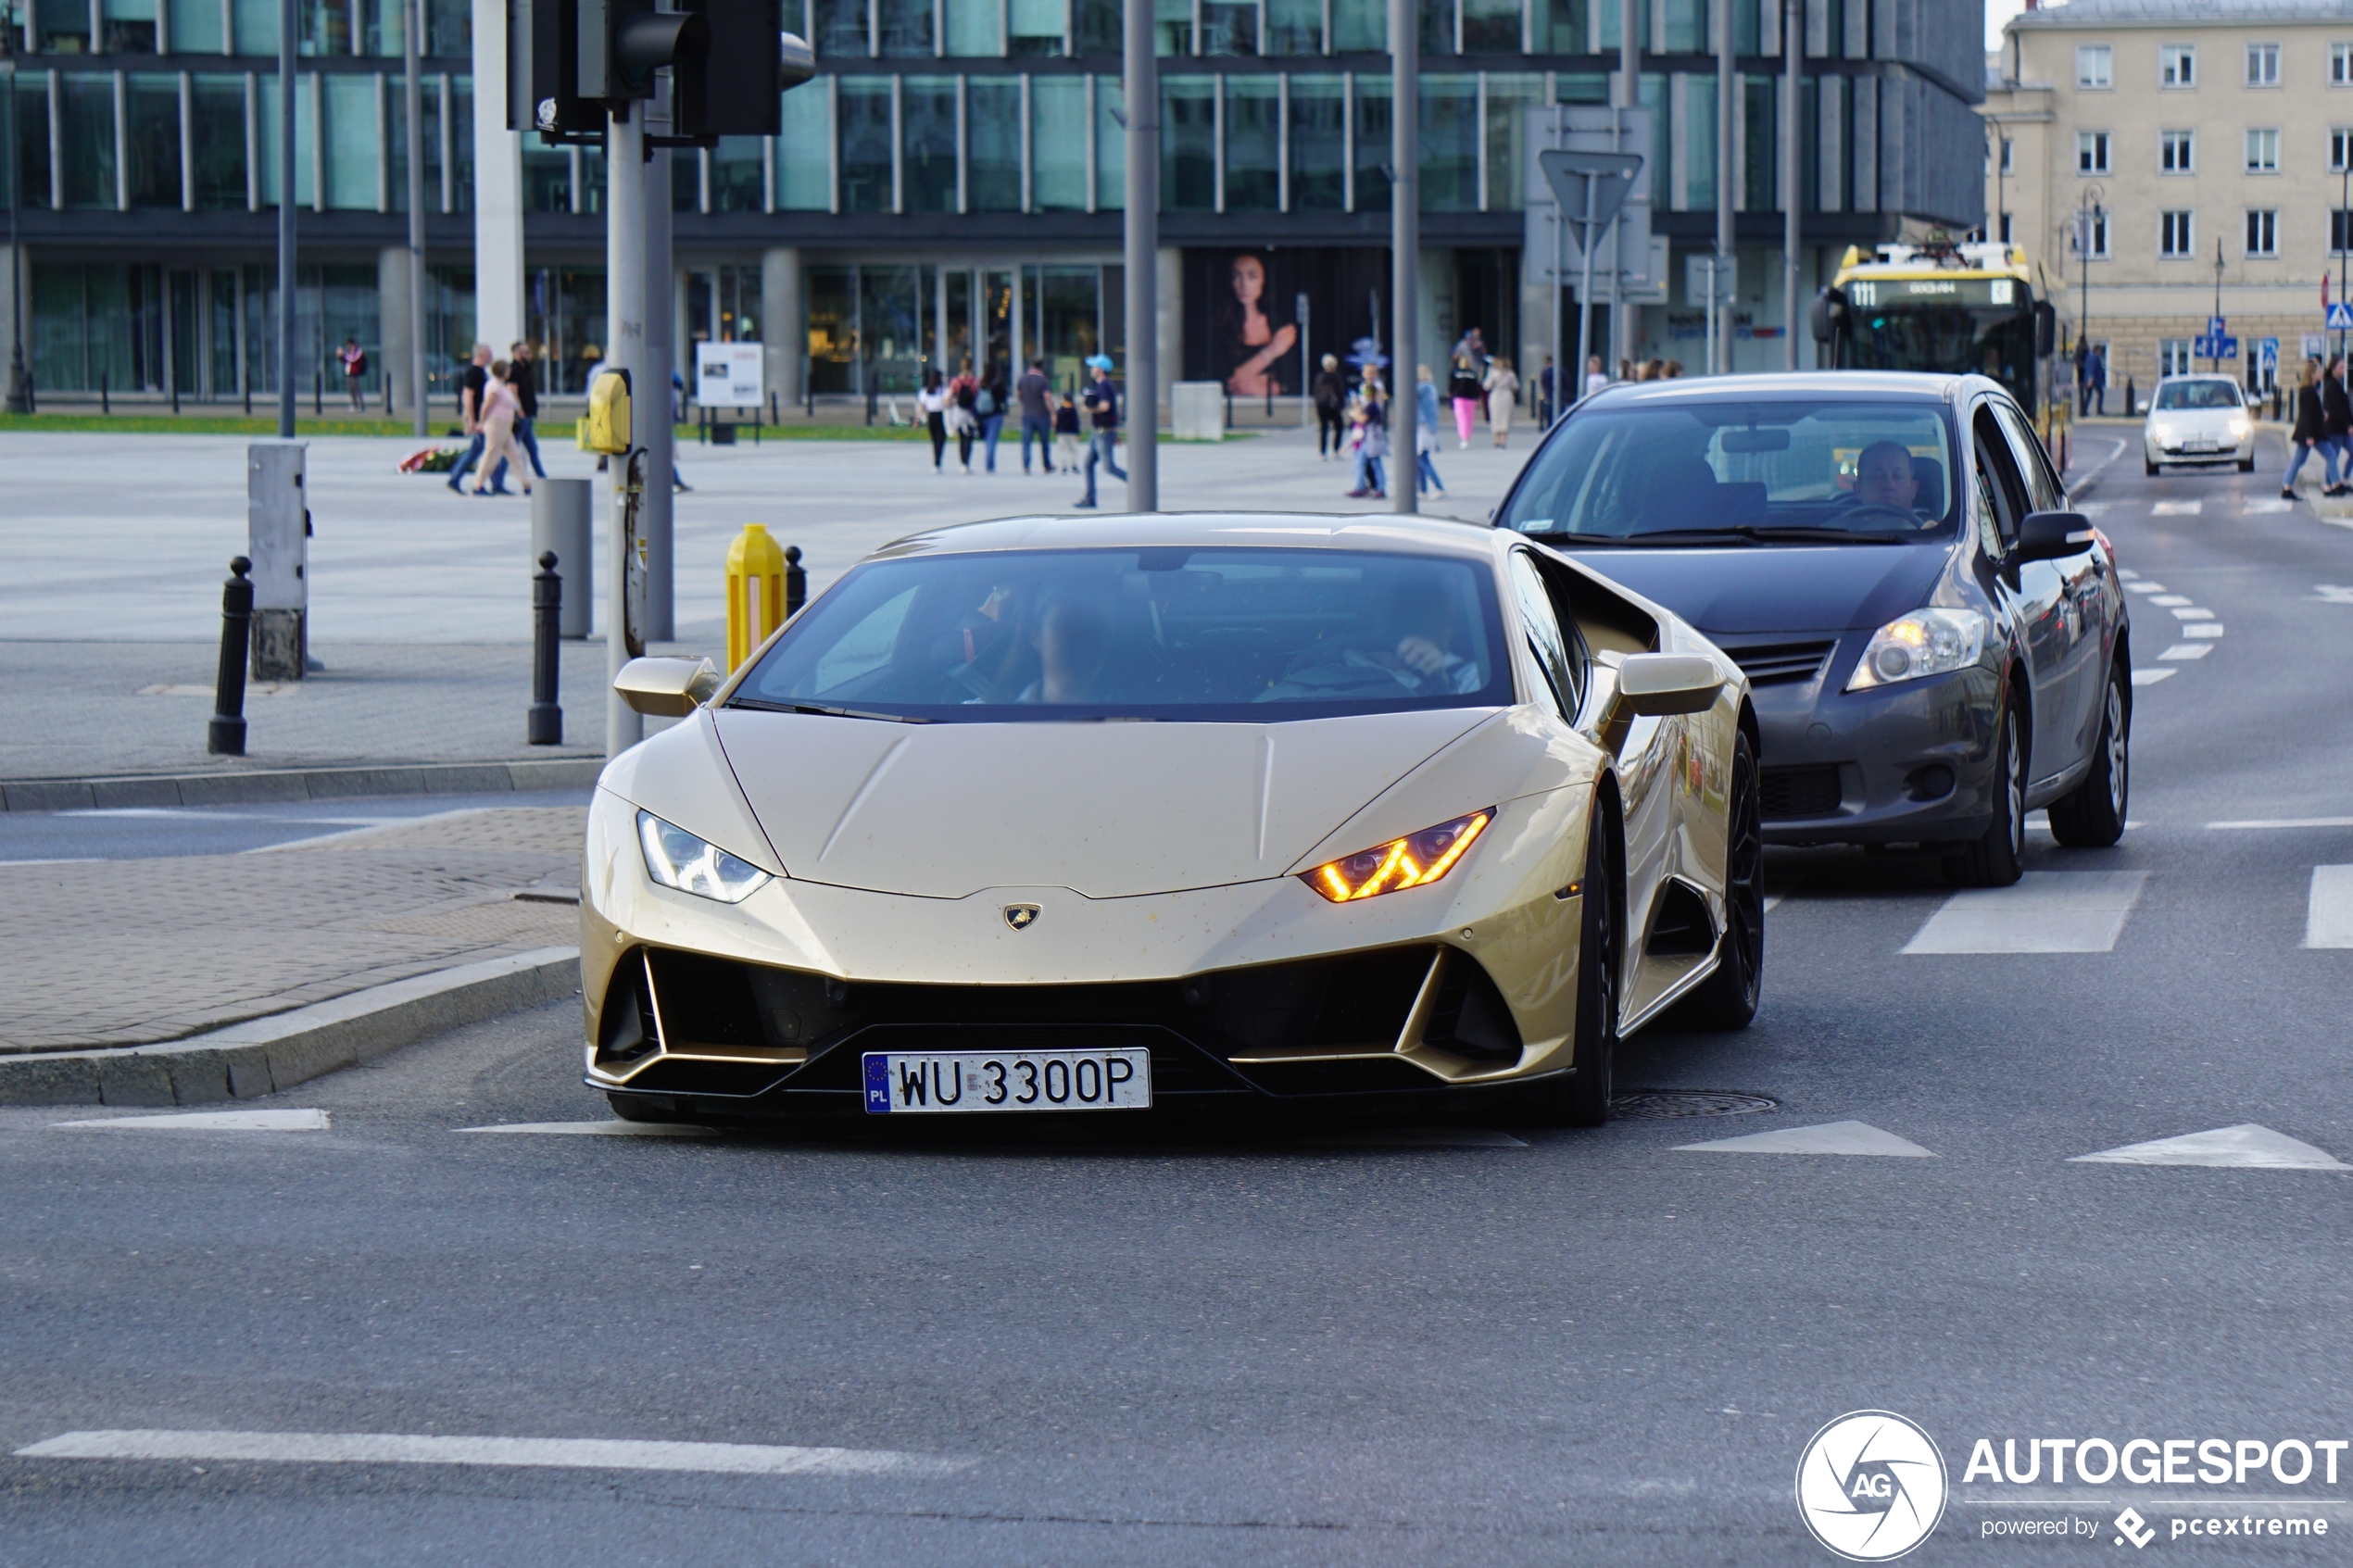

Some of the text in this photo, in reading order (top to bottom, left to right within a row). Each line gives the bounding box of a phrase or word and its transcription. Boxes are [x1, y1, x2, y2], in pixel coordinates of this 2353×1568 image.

[1853, 282, 1876, 307] 111
[899, 1056, 1133, 1106] WU 3300P
[871, 1090, 887, 1103] PL
